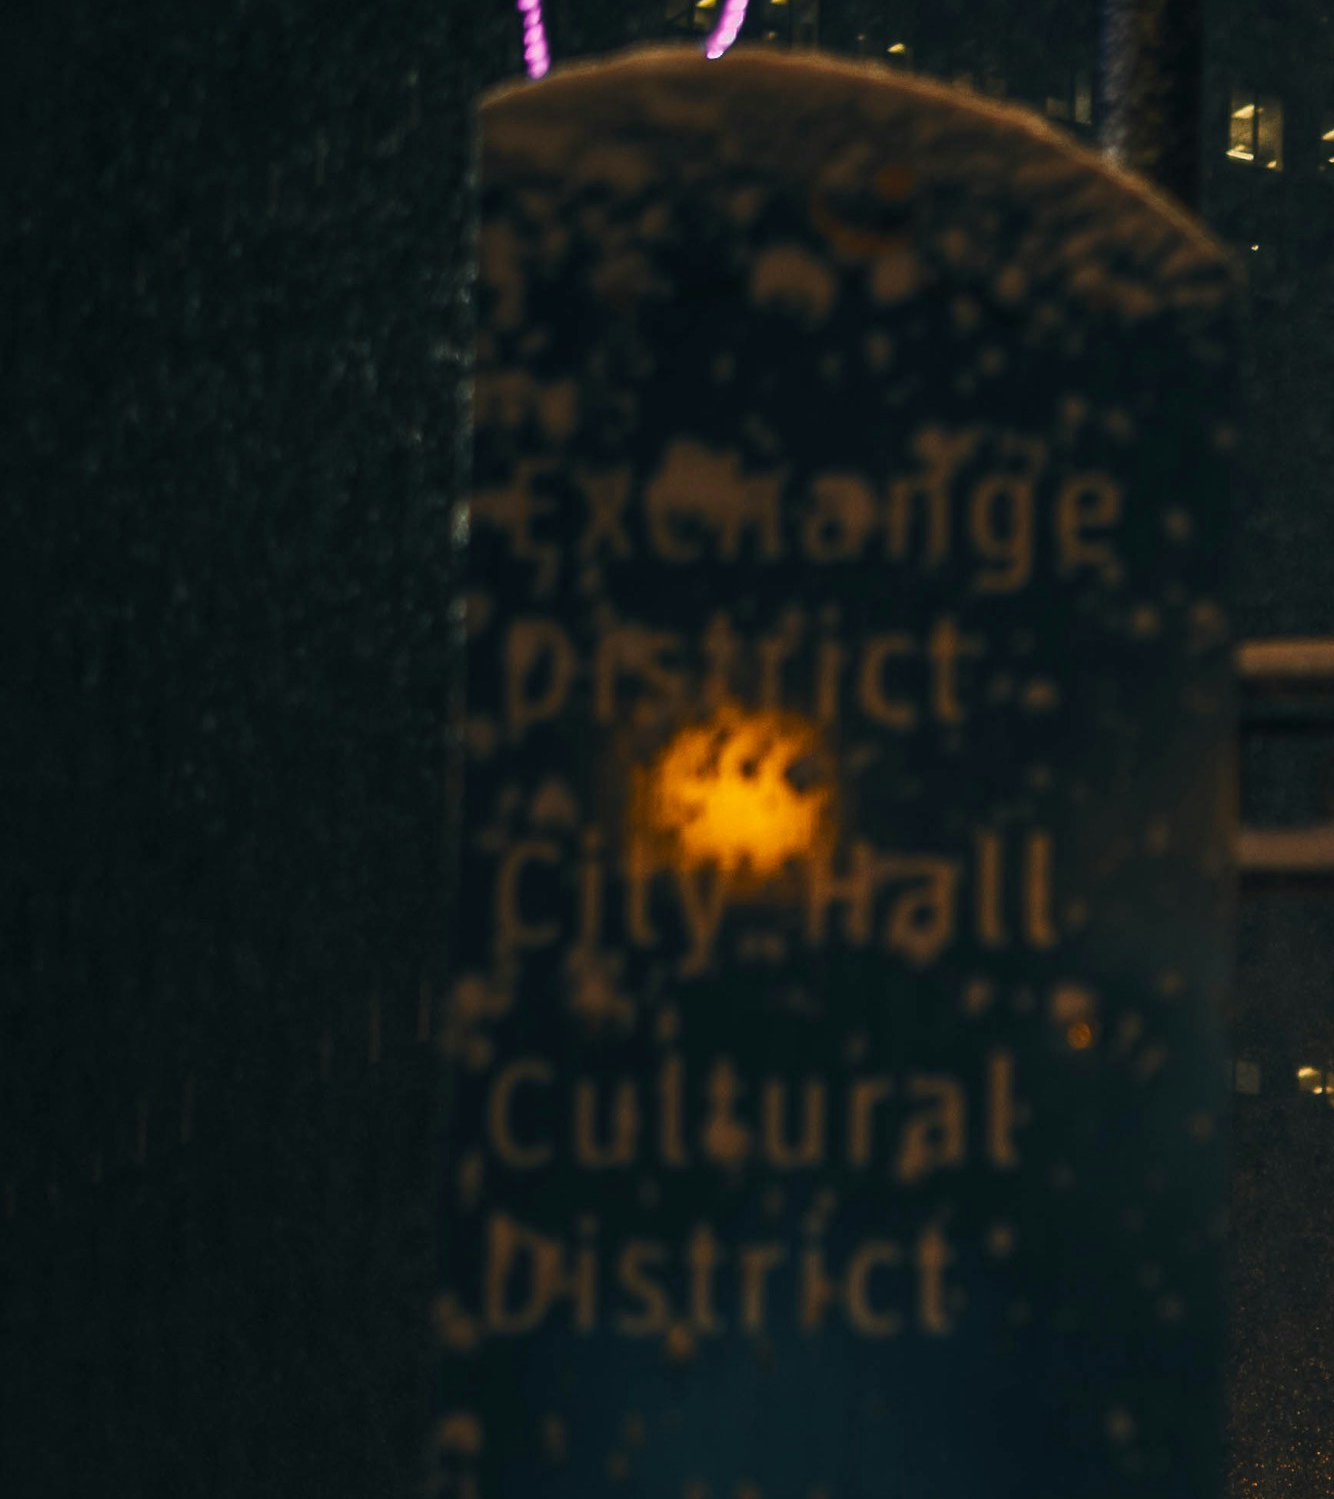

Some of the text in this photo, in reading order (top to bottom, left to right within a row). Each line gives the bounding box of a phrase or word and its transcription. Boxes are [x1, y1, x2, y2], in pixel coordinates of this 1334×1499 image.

[801, 829, 1057, 954] Hall
[486, 1049, 1018, 1171] Cultural
[482, 1218, 955, 1338] District
